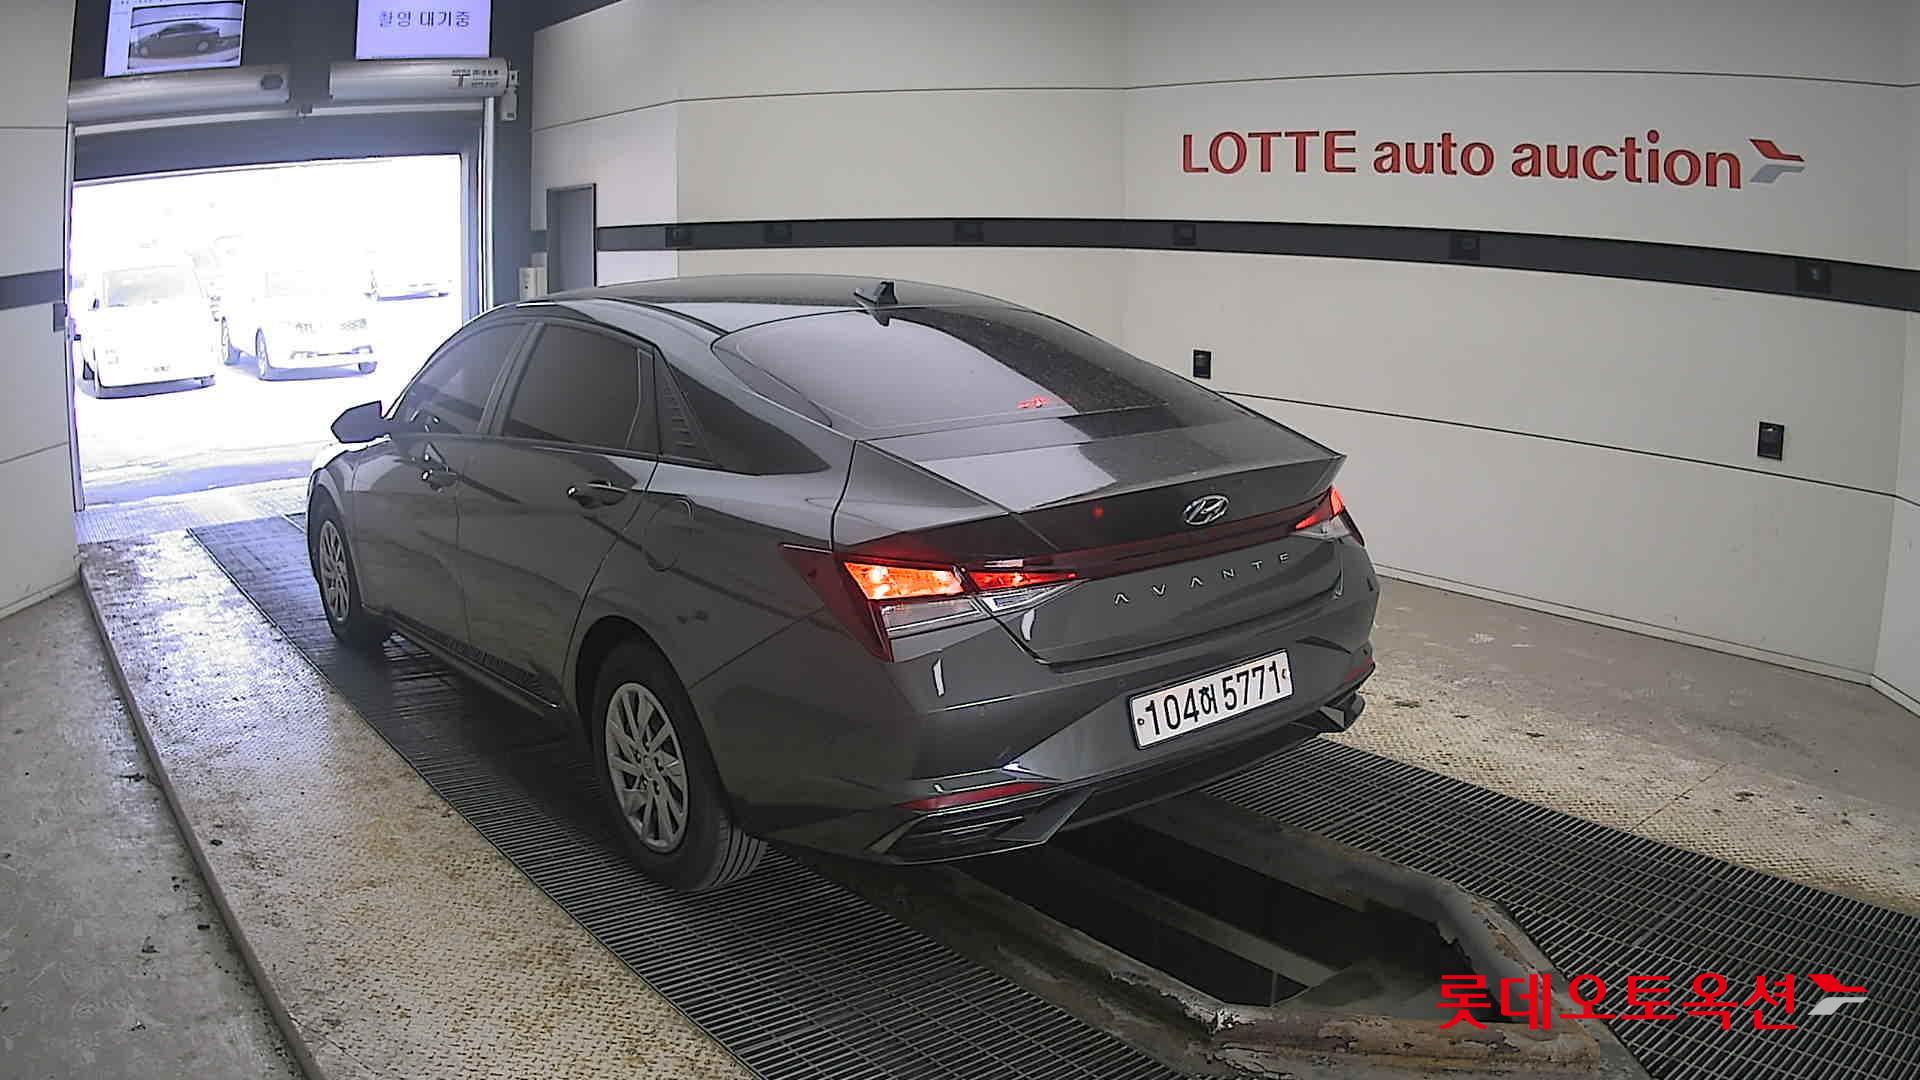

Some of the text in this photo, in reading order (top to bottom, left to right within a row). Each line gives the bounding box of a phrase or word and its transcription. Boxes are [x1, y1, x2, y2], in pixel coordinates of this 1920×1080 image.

[419, 10, 470, 28] 대기중
[1182, 129, 1742, 189] LOTTE auto auction
[1114, 552, 1289, 605] AVANTE
[1222, 660, 1281, 711] 5771
